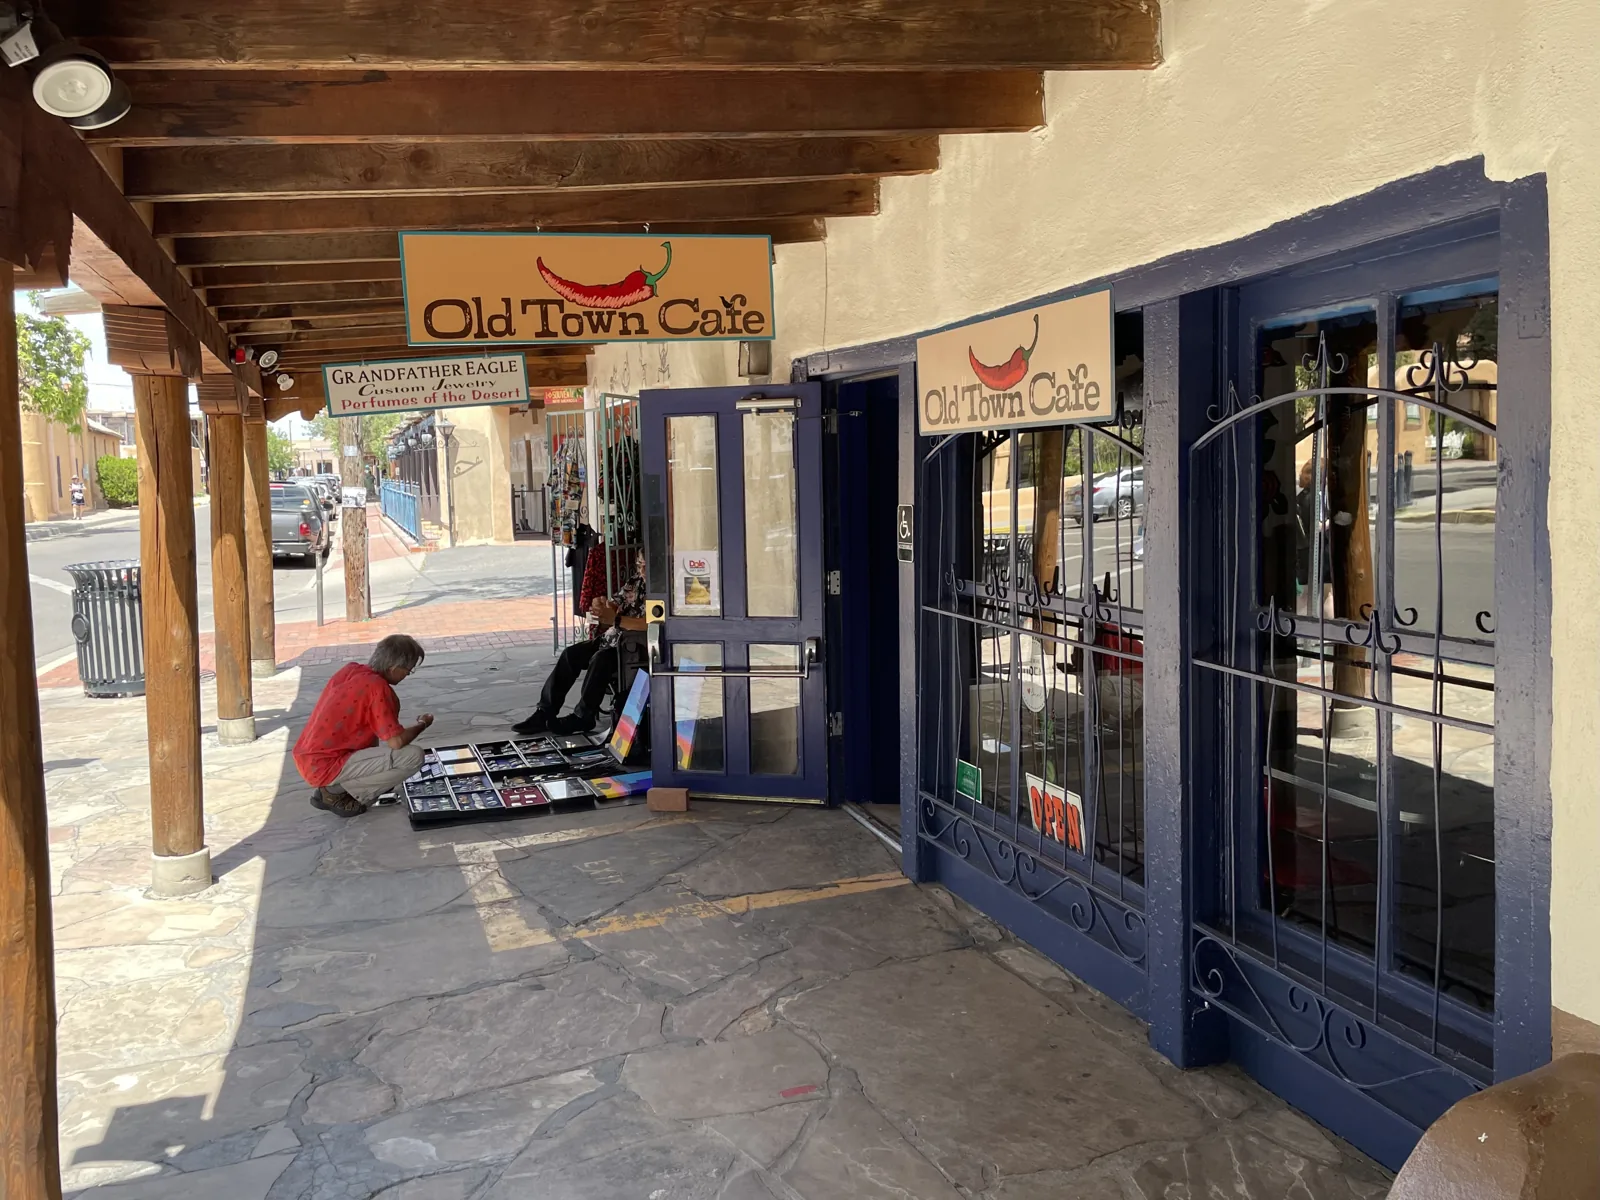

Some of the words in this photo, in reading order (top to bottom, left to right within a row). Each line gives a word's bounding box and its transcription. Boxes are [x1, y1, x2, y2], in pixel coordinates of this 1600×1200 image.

[423, 297, 516, 339] Old
[521, 299, 649, 338] Town
[658, 294, 765, 336] Cafe
[332, 364, 462, 385] GRANDFATHER
[466, 360, 518, 376] EAGLE
[341, 397, 418, 410] Perfumes
[424, 392, 437, 404] of
[443, 391, 466, 403] the
[472, 388, 520, 401] Desert
[358, 384, 425, 396] Custom
[432, 379, 496, 391] Jewelry
[925, 385, 960, 426] Old
[962, 383, 1026, 422] Town
[1029, 363, 1100, 416] Cafe
[689, 559, 705, 569] Dole
[1030, 785, 1081, 850] OPEN
